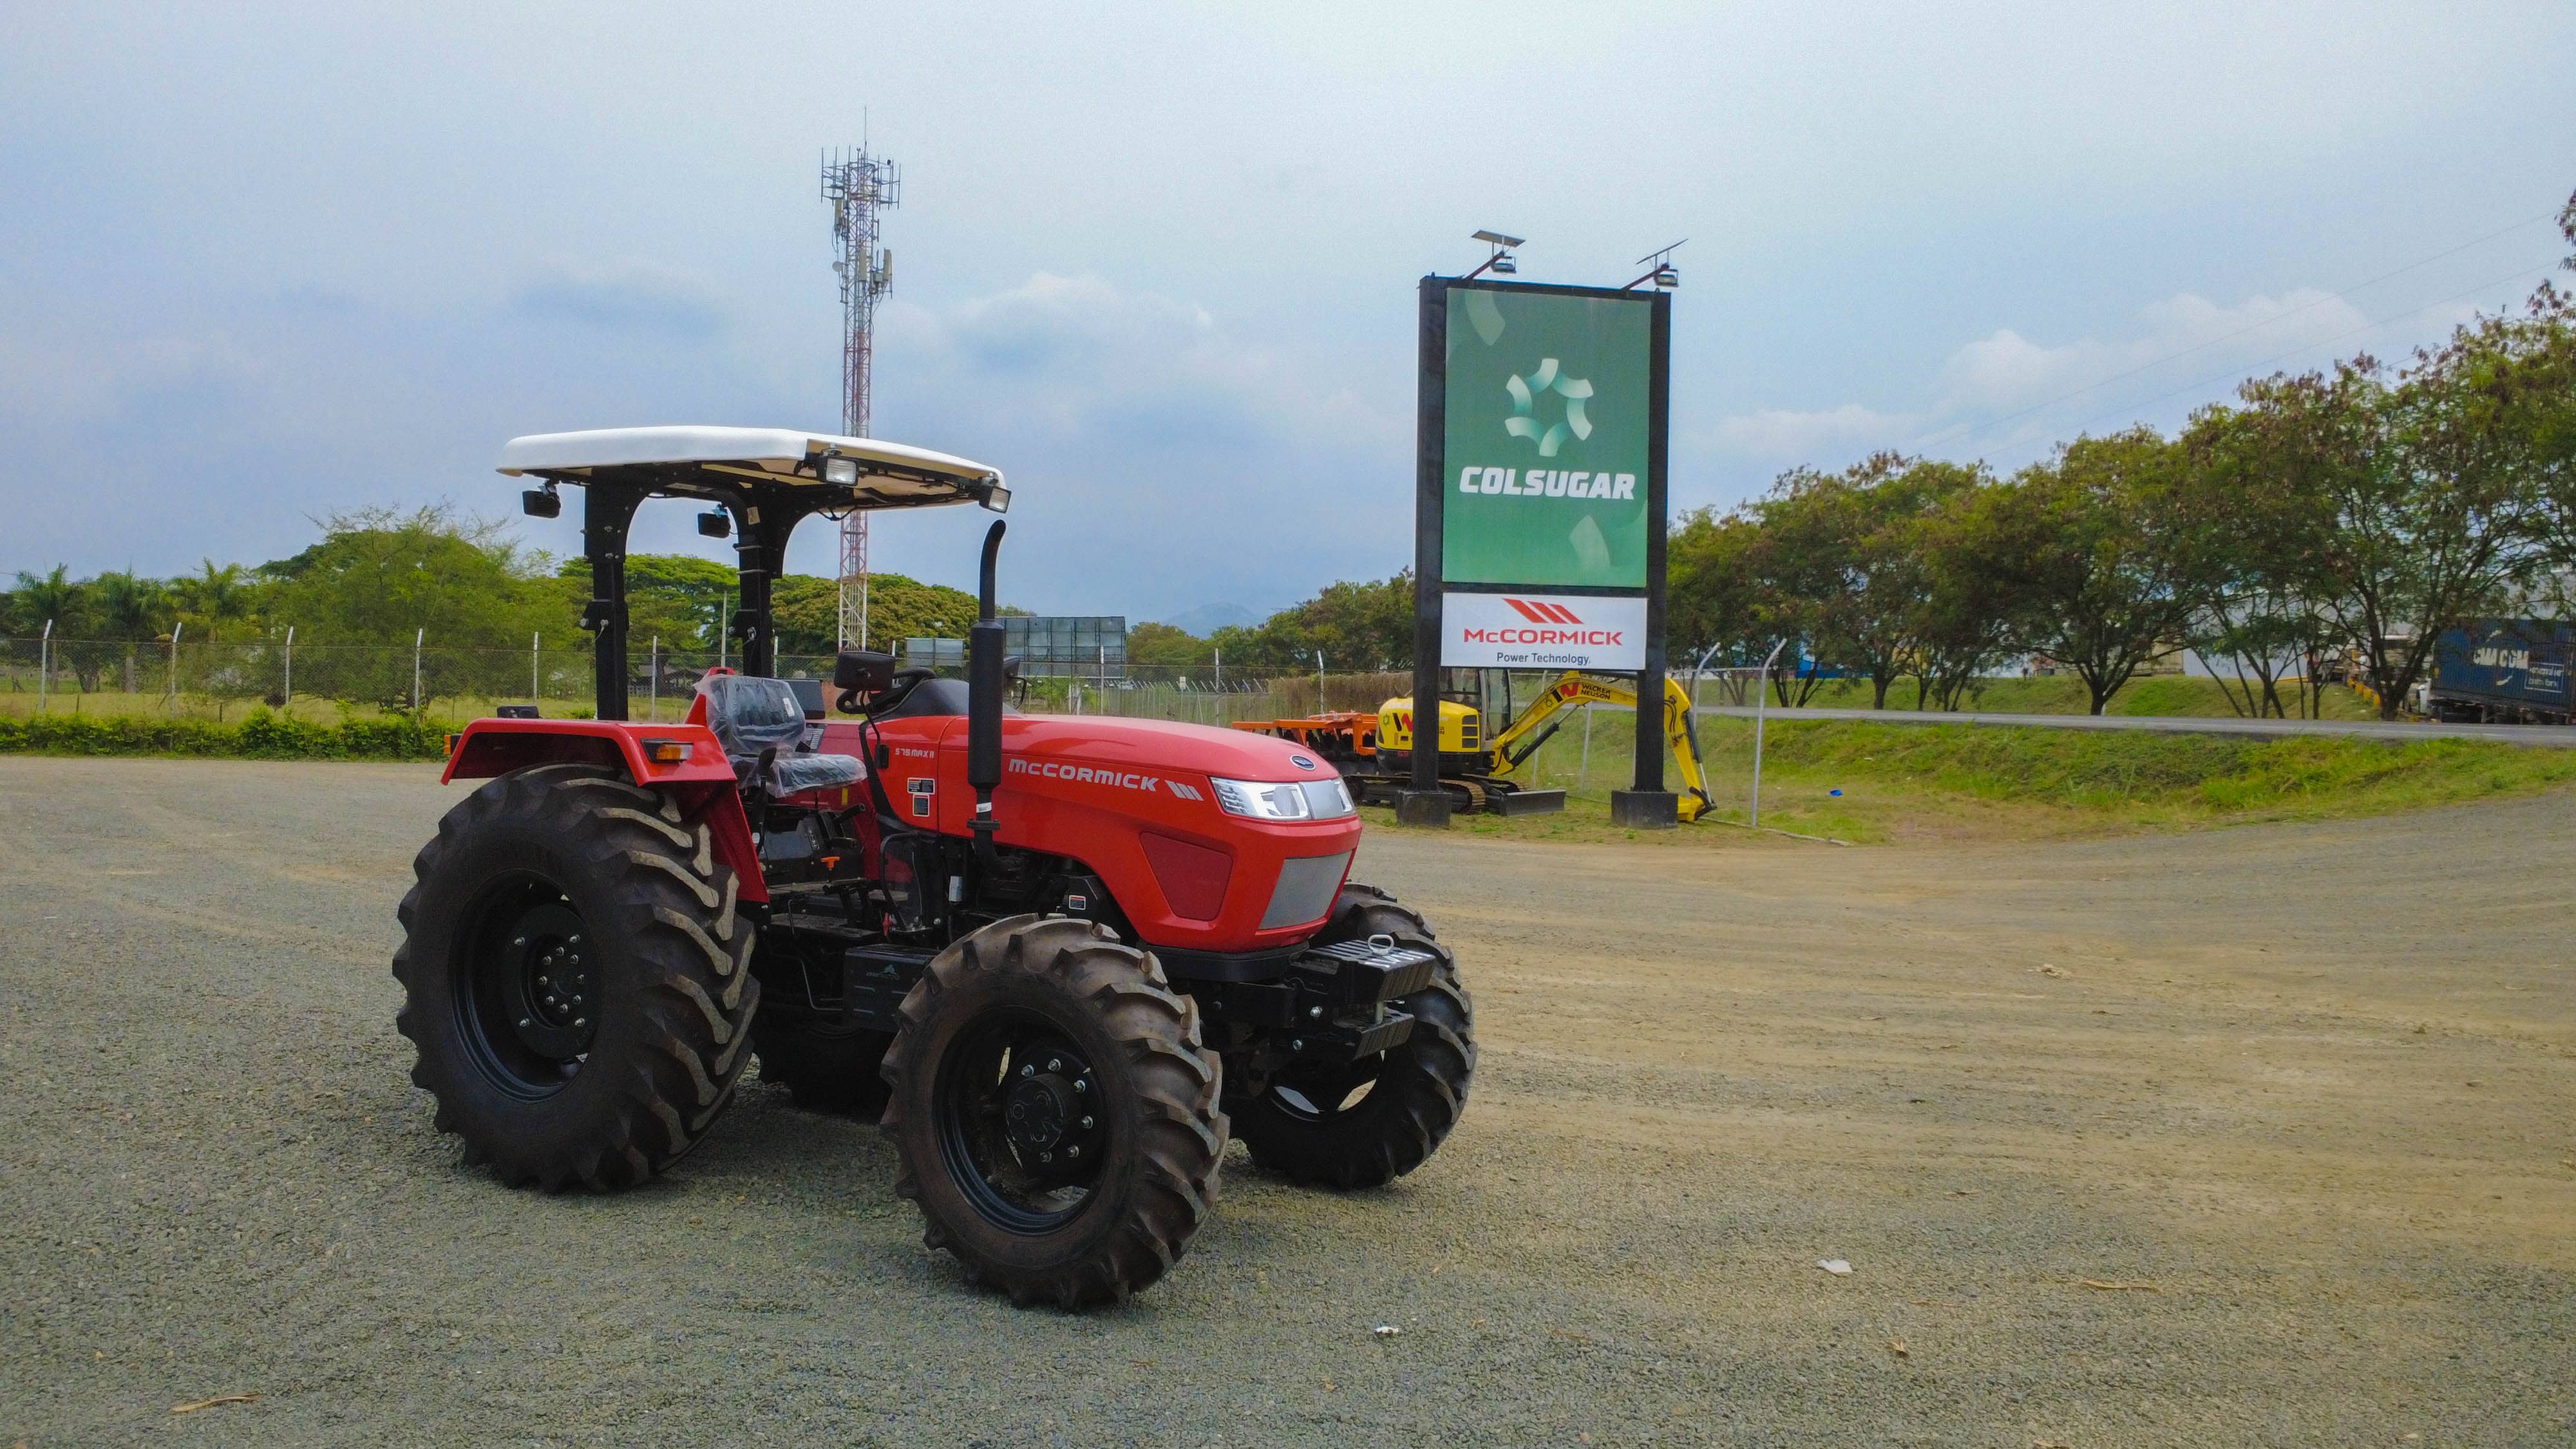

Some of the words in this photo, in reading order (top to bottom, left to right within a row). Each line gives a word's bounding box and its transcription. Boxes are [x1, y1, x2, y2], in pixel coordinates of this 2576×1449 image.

[1459, 466, 1636, 500] COLSUGAR
[1464, 628, 1624, 646] McCORMICK
[1497, 652, 1528, 662] Power
[1582, 683, 1611, 694] WACKER
[1580, 690, 1610, 700] NEUSON
[911, 749, 928, 757] MAX
[1009, 759, 1159, 791] McCORMICK
